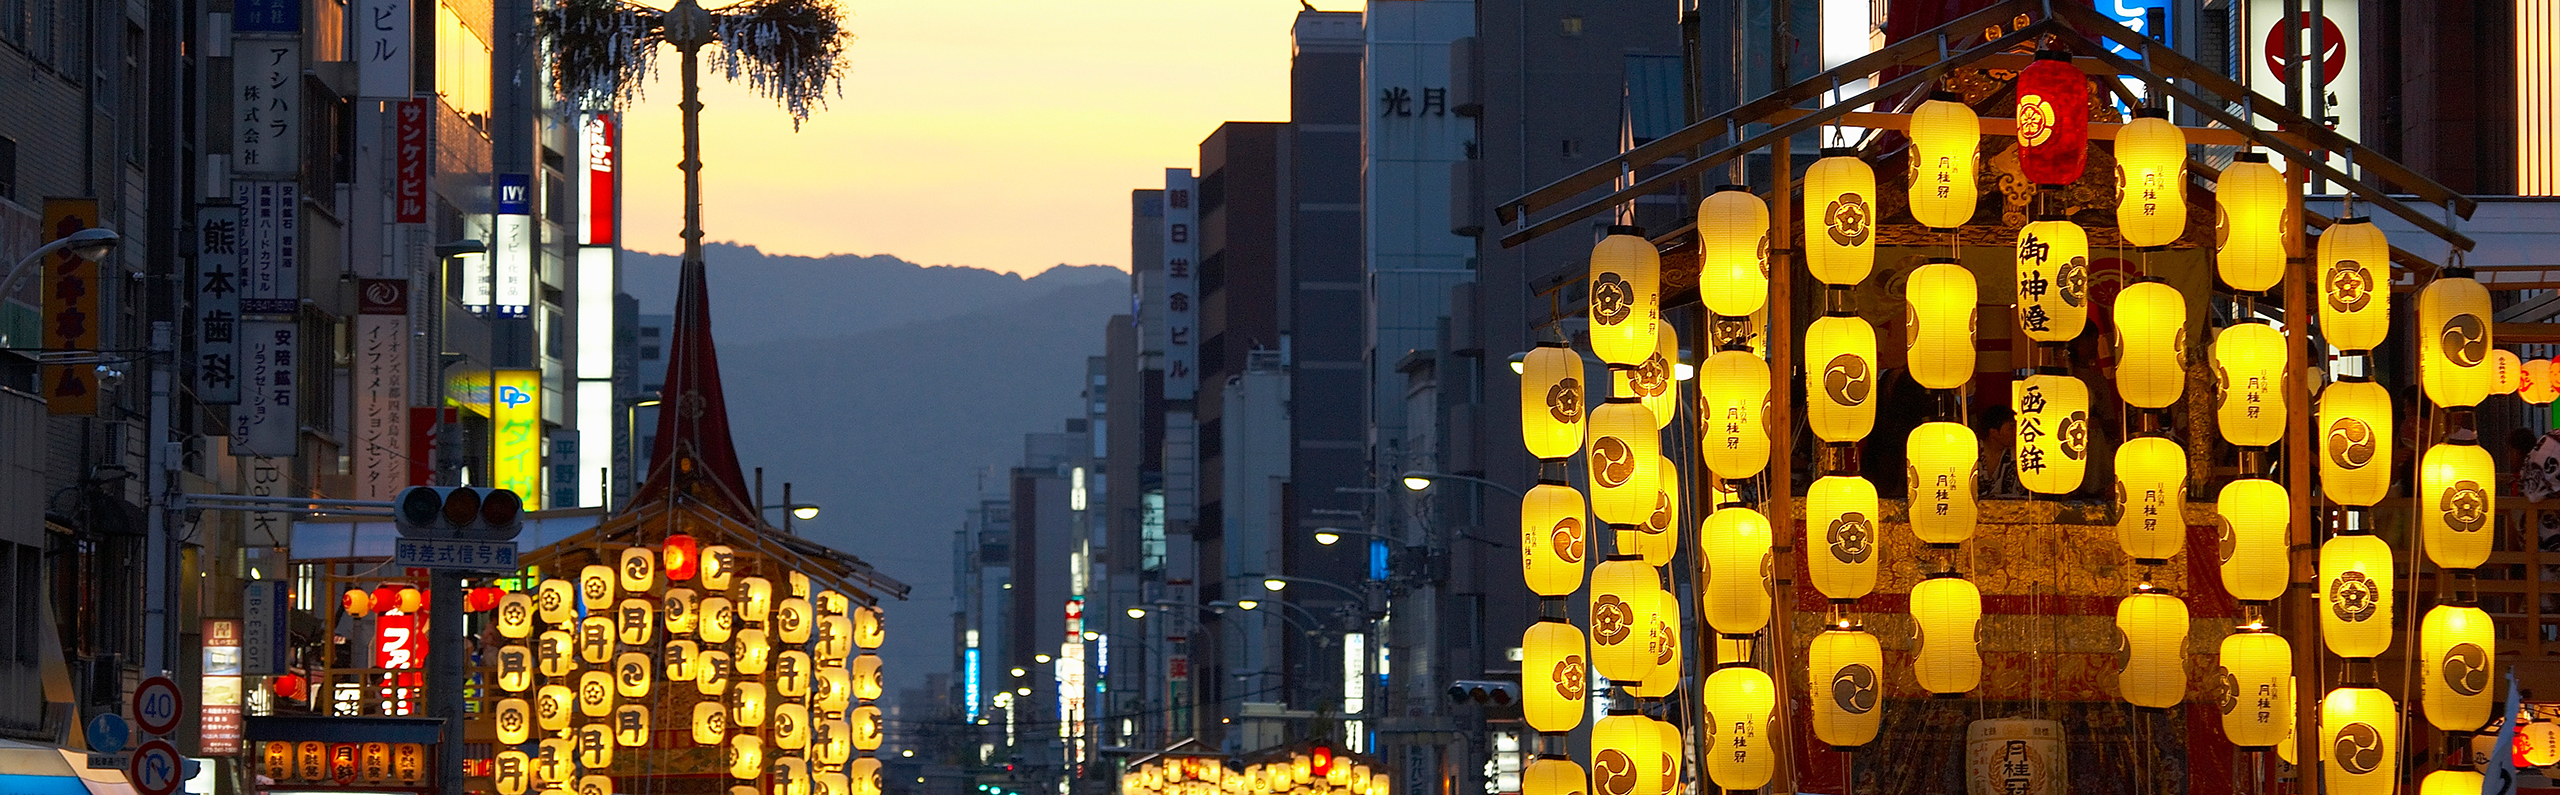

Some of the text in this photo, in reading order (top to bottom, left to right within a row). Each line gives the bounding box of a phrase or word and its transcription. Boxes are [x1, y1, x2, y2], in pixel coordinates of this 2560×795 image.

[371, 3, 398, 63] ビル
[270, 48, 289, 138] アシハラ
[1381, 87, 1447, 118] 光月
[244, 85, 260, 165] 株式会社
[591, 118, 612, 173] azbil
[402, 105, 423, 216] サンケイビル
[1937, 156, 1950, 199] 月桂冠
[502, 185, 525, 201] IVY
[2143, 173, 2156, 216] 月桂冠
[508, 223, 520, 296] アイビー化粧品
[1170, 189, 1189, 378] 朝日生命ビル
[2019, 232, 2050, 332] 御神燈
[203, 219, 235, 389] 熊本歯科
[254, 342, 266, 425] リラクゼーション
[2247, 376, 2261, 419] 月桂冠
[238, 415, 249, 446] サロン
[366, 325, 381, 498] インフォメーションセンター
[1726, 407, 1740, 450] 月桂冠
[1936, 475, 1949, 516] 月桂冠
[2143, 489, 2157, 531] 月桂冠
[400, 543, 512, 565] 時差式信号機
[145, 693, 171, 718] 40
[2258, 684, 2270, 723] 月桂冠
[336, 746, 354, 779] 月鉾
[1733, 721, 1747, 763] 月桂冠
[2003, 741, 2031, 795] 月桂冠
